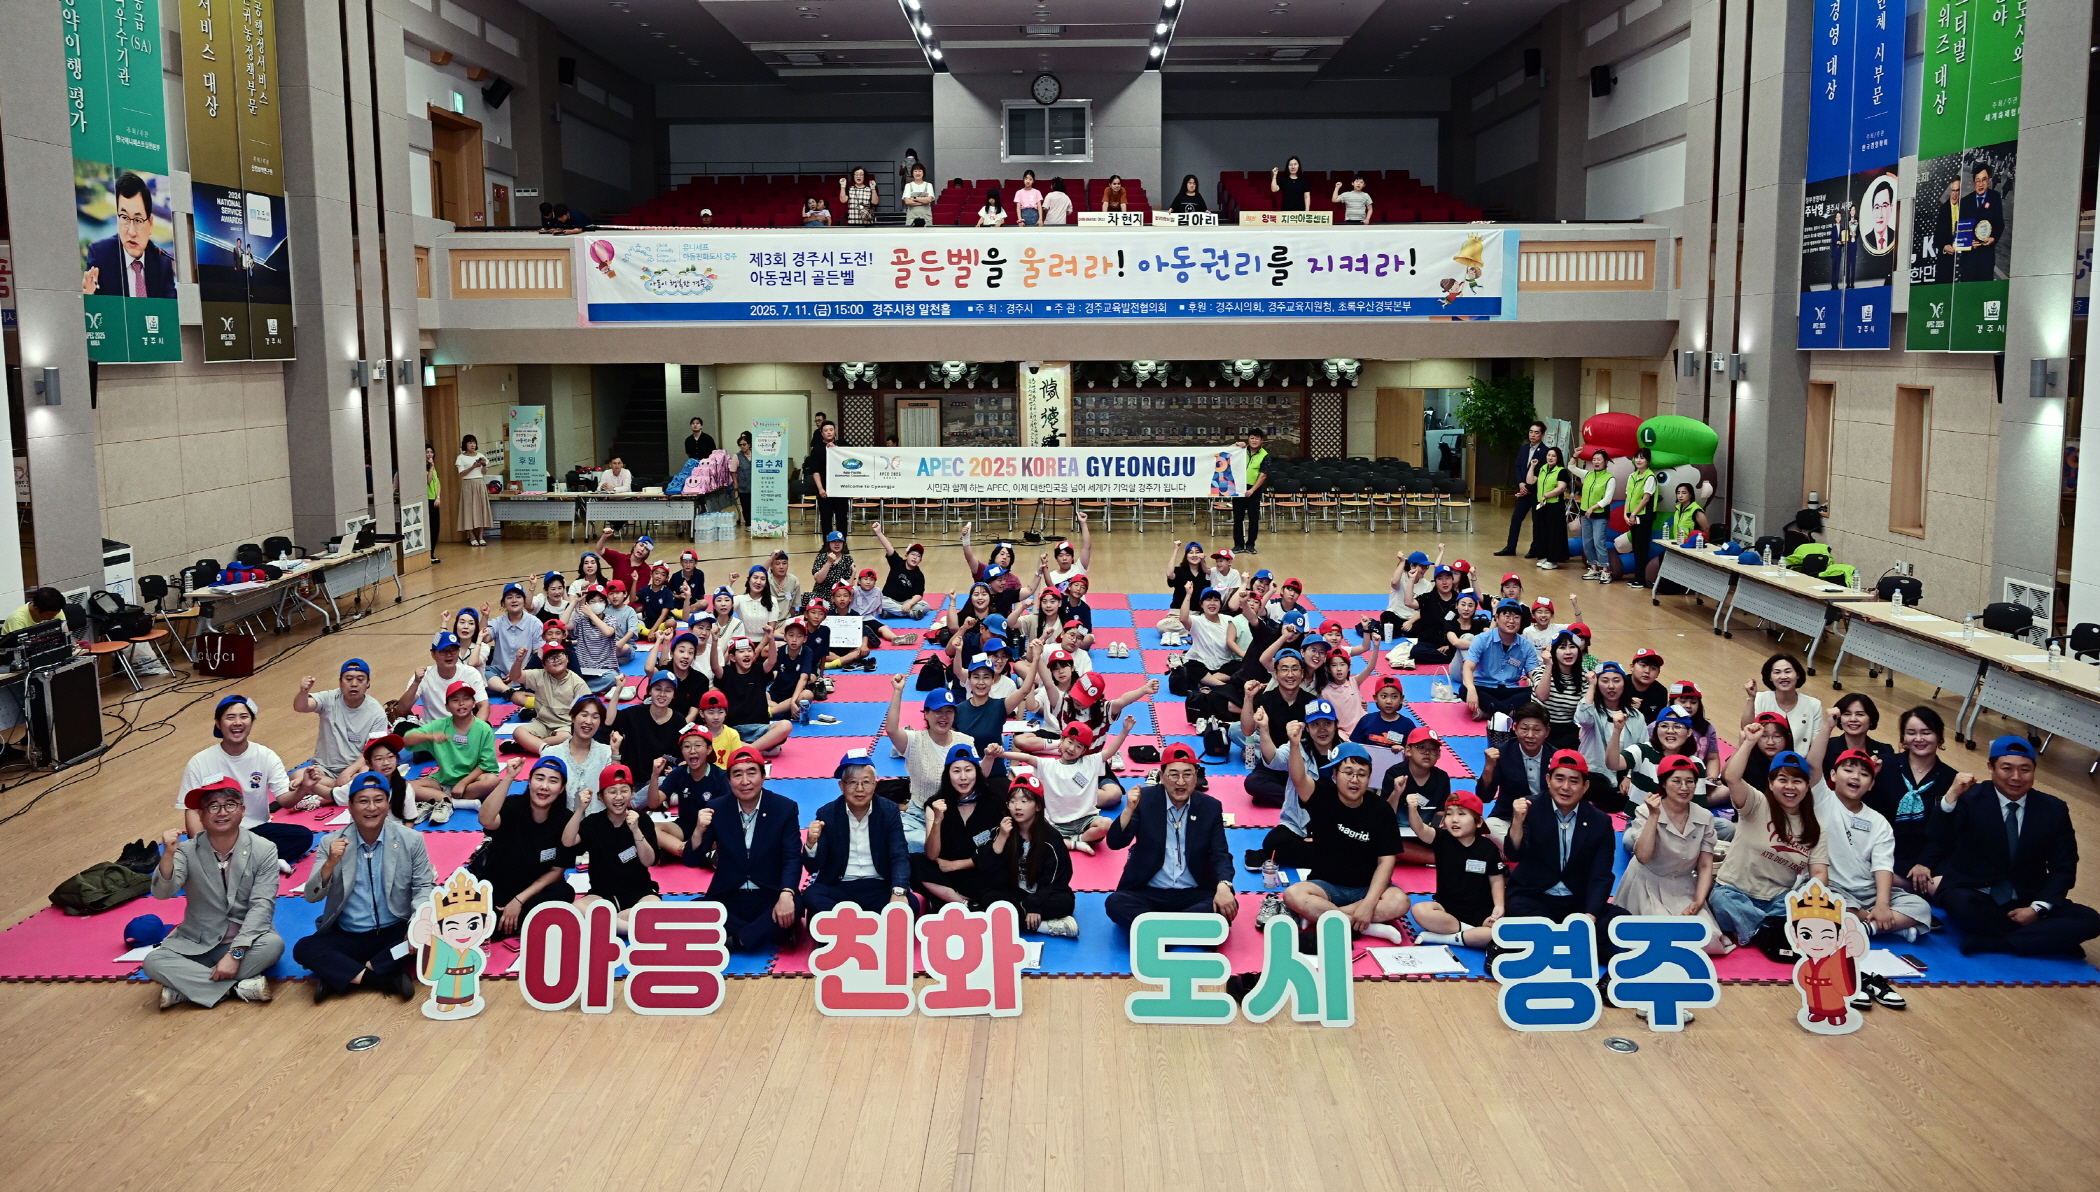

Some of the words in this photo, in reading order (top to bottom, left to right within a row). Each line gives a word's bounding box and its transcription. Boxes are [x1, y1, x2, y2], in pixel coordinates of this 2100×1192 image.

[1993, 0, 2008, 27] 야
[198, 0, 216, 61] 서비스
[1953, 0, 1969, 63] 티벌
[131, 34, 152, 54] (SA)
[243, 0, 257, 115] 귀농정책부문
[1825, 54, 1838, 101] 대상
[1873, 42, 1885, 106] 시부문
[203, 72, 219, 117] 대상
[1933, 63, 1948, 116] 대상
[69, 86, 88, 133] 평가
[227, 190, 242, 200] 2024
[216, 197, 243, 208] NATIONAL
[220, 206, 243, 217] SERVICE
[1804, 202, 1824, 218] 주낙영
[220, 215, 243, 225] AWARDS
[1178, 214, 1214, 226] 김아리
[1281, 214, 1330, 224] 지역아동센터
[683, 243, 709, 251] 유니세프
[683, 253, 722, 261] 아동친화도시
[723, 253, 737, 261] 경주
[749, 252, 786, 268] 제3회
[792, 251, 834, 267] 경주시
[839, 251, 873, 267] 도전!
[890, 247, 1007, 289] 골든벨을
[1020, 247, 1125, 288] 울려라!
[1138, 246, 1293, 287] 아동권리를
[1307, 248, 1416, 277] 지켜라!
[669, 279, 690, 290] 행복한
[750, 270, 806, 286] 아동권리
[811, 270, 855, 286] 골든벨
[750, 304, 780, 316] 2025.
[782, 304, 792, 316] 7.
[795, 304, 811, 316] 11.
[813, 304, 832, 316] (금)
[834, 304, 864, 316] 15:00
[872, 303, 916, 316] 경주시청
[919, 303, 951, 316] 알천홀
[1006, 303, 1033, 314] 경주시
[1085, 302, 1167, 313] 경주교육발전협의회
[1187, 302, 1207, 313] 후원
[1215, 301, 1264, 314] 경주시의회,
[1268, 301, 1335, 313] 경주교육지원청,
[1338, 300, 1412, 312] 초록우산경북본부
[1976, 325, 2005, 334] 경주시
[1583, 426, 1592, 436] M
[1645, 429, 1653, 443] L
[519, 456, 536, 465] 후원
[756, 459, 784, 469] 접수처
[917, 457, 965, 477] APEC
[969, 457, 1017, 477] 2025
[1021, 456, 1079, 477] KOREA
[1086, 456, 1196, 477] GYEONGJU
[927, 483, 950, 493] 시민과
[952, 483, 968, 493] 함께
[969, 483, 984, 493] 하는
[986, 483, 1010, 493] APEC,
[1012, 483, 1029, 493] 이제
[1030, 483, 1068, 493] 대한민국을
[1070, 483, 1086, 493] 넘어
[1088, 483, 1111, 493] 세계가
[1113, 483, 1136, 493] 기억할
[1138, 483, 1161, 493] 경주가
[1163, 483, 1186, 493] 됩니다
[197, 651, 235, 662] GUCCI
[525, 905, 723, 1009] 아동
[815, 906, 1025, 1010] 친화
[1131, 916, 1349, 1021] 도시
[1498, 919, 1715, 1025] 경주
